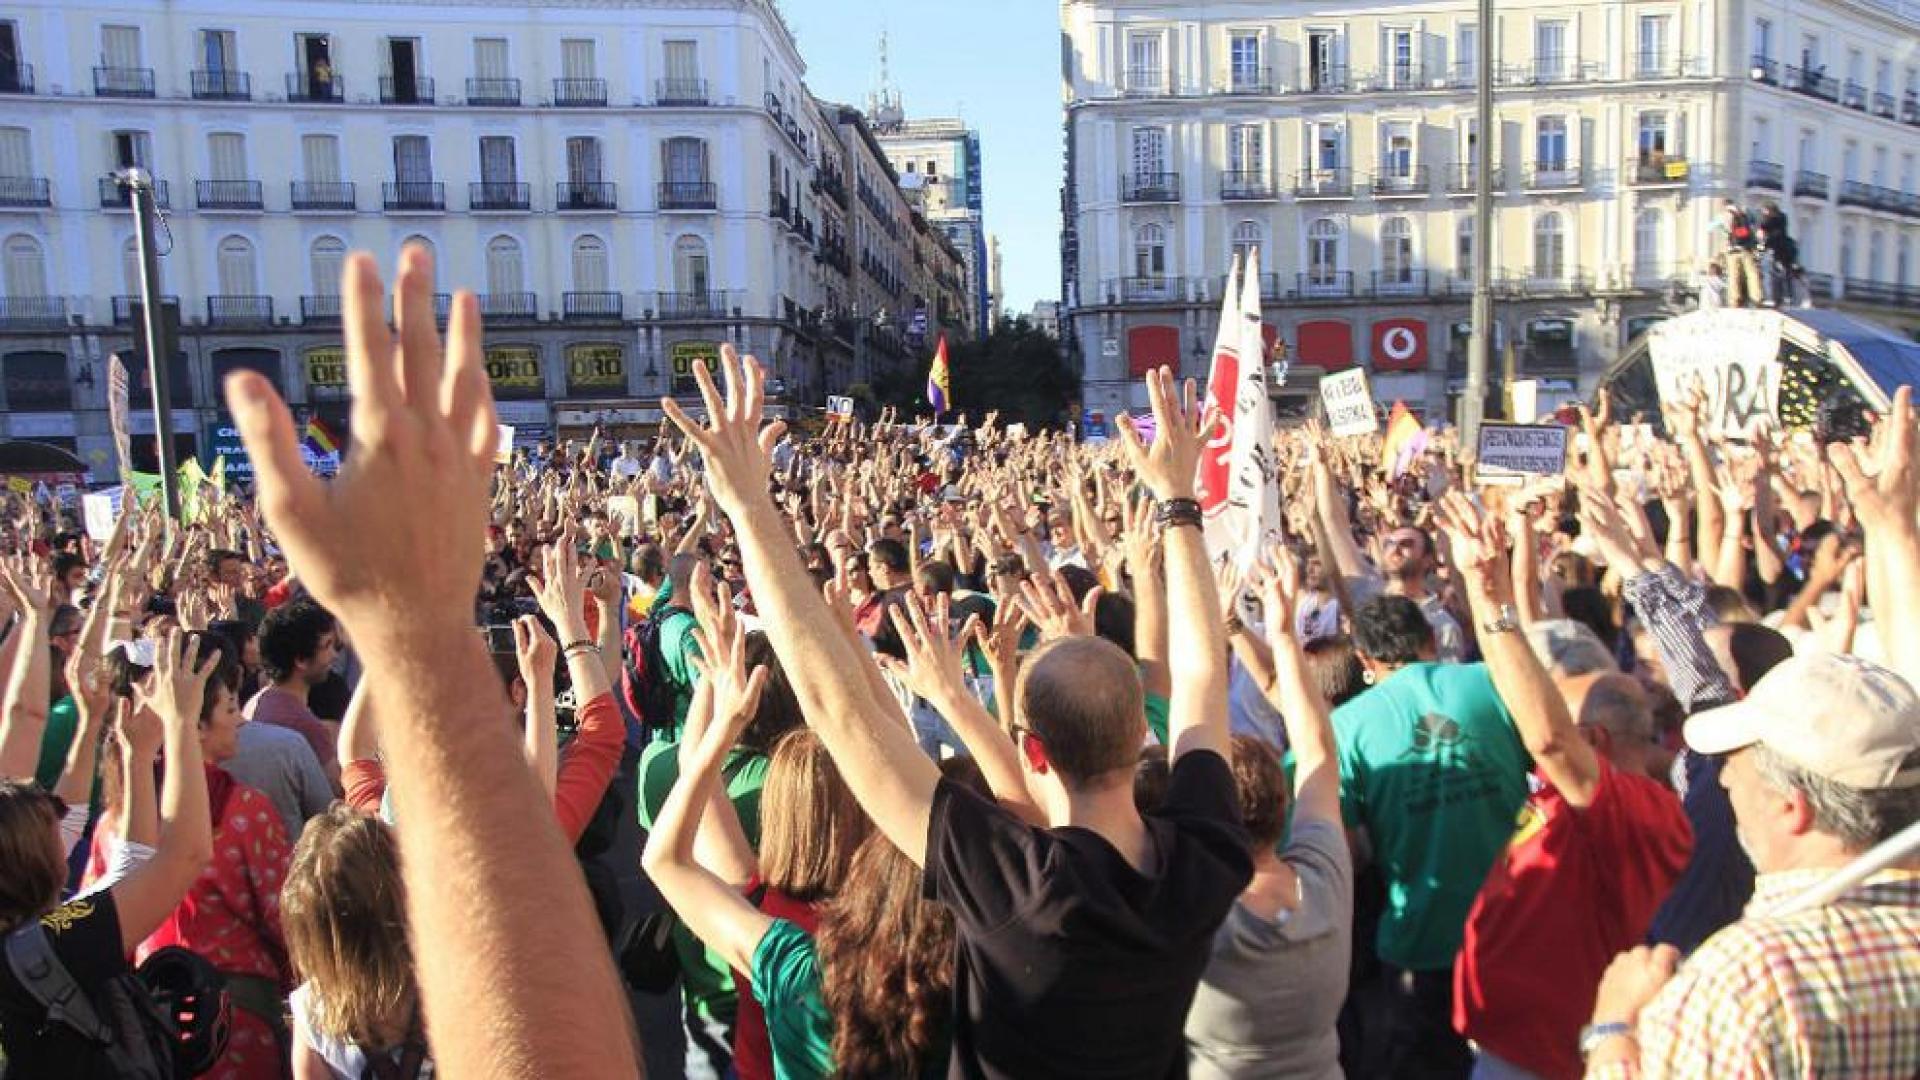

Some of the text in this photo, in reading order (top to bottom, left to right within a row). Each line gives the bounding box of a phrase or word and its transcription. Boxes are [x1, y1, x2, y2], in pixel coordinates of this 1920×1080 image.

[311, 364, 346, 382] OR
[486, 361, 538, 378] ORO
[572, 358, 622, 376] ORO
